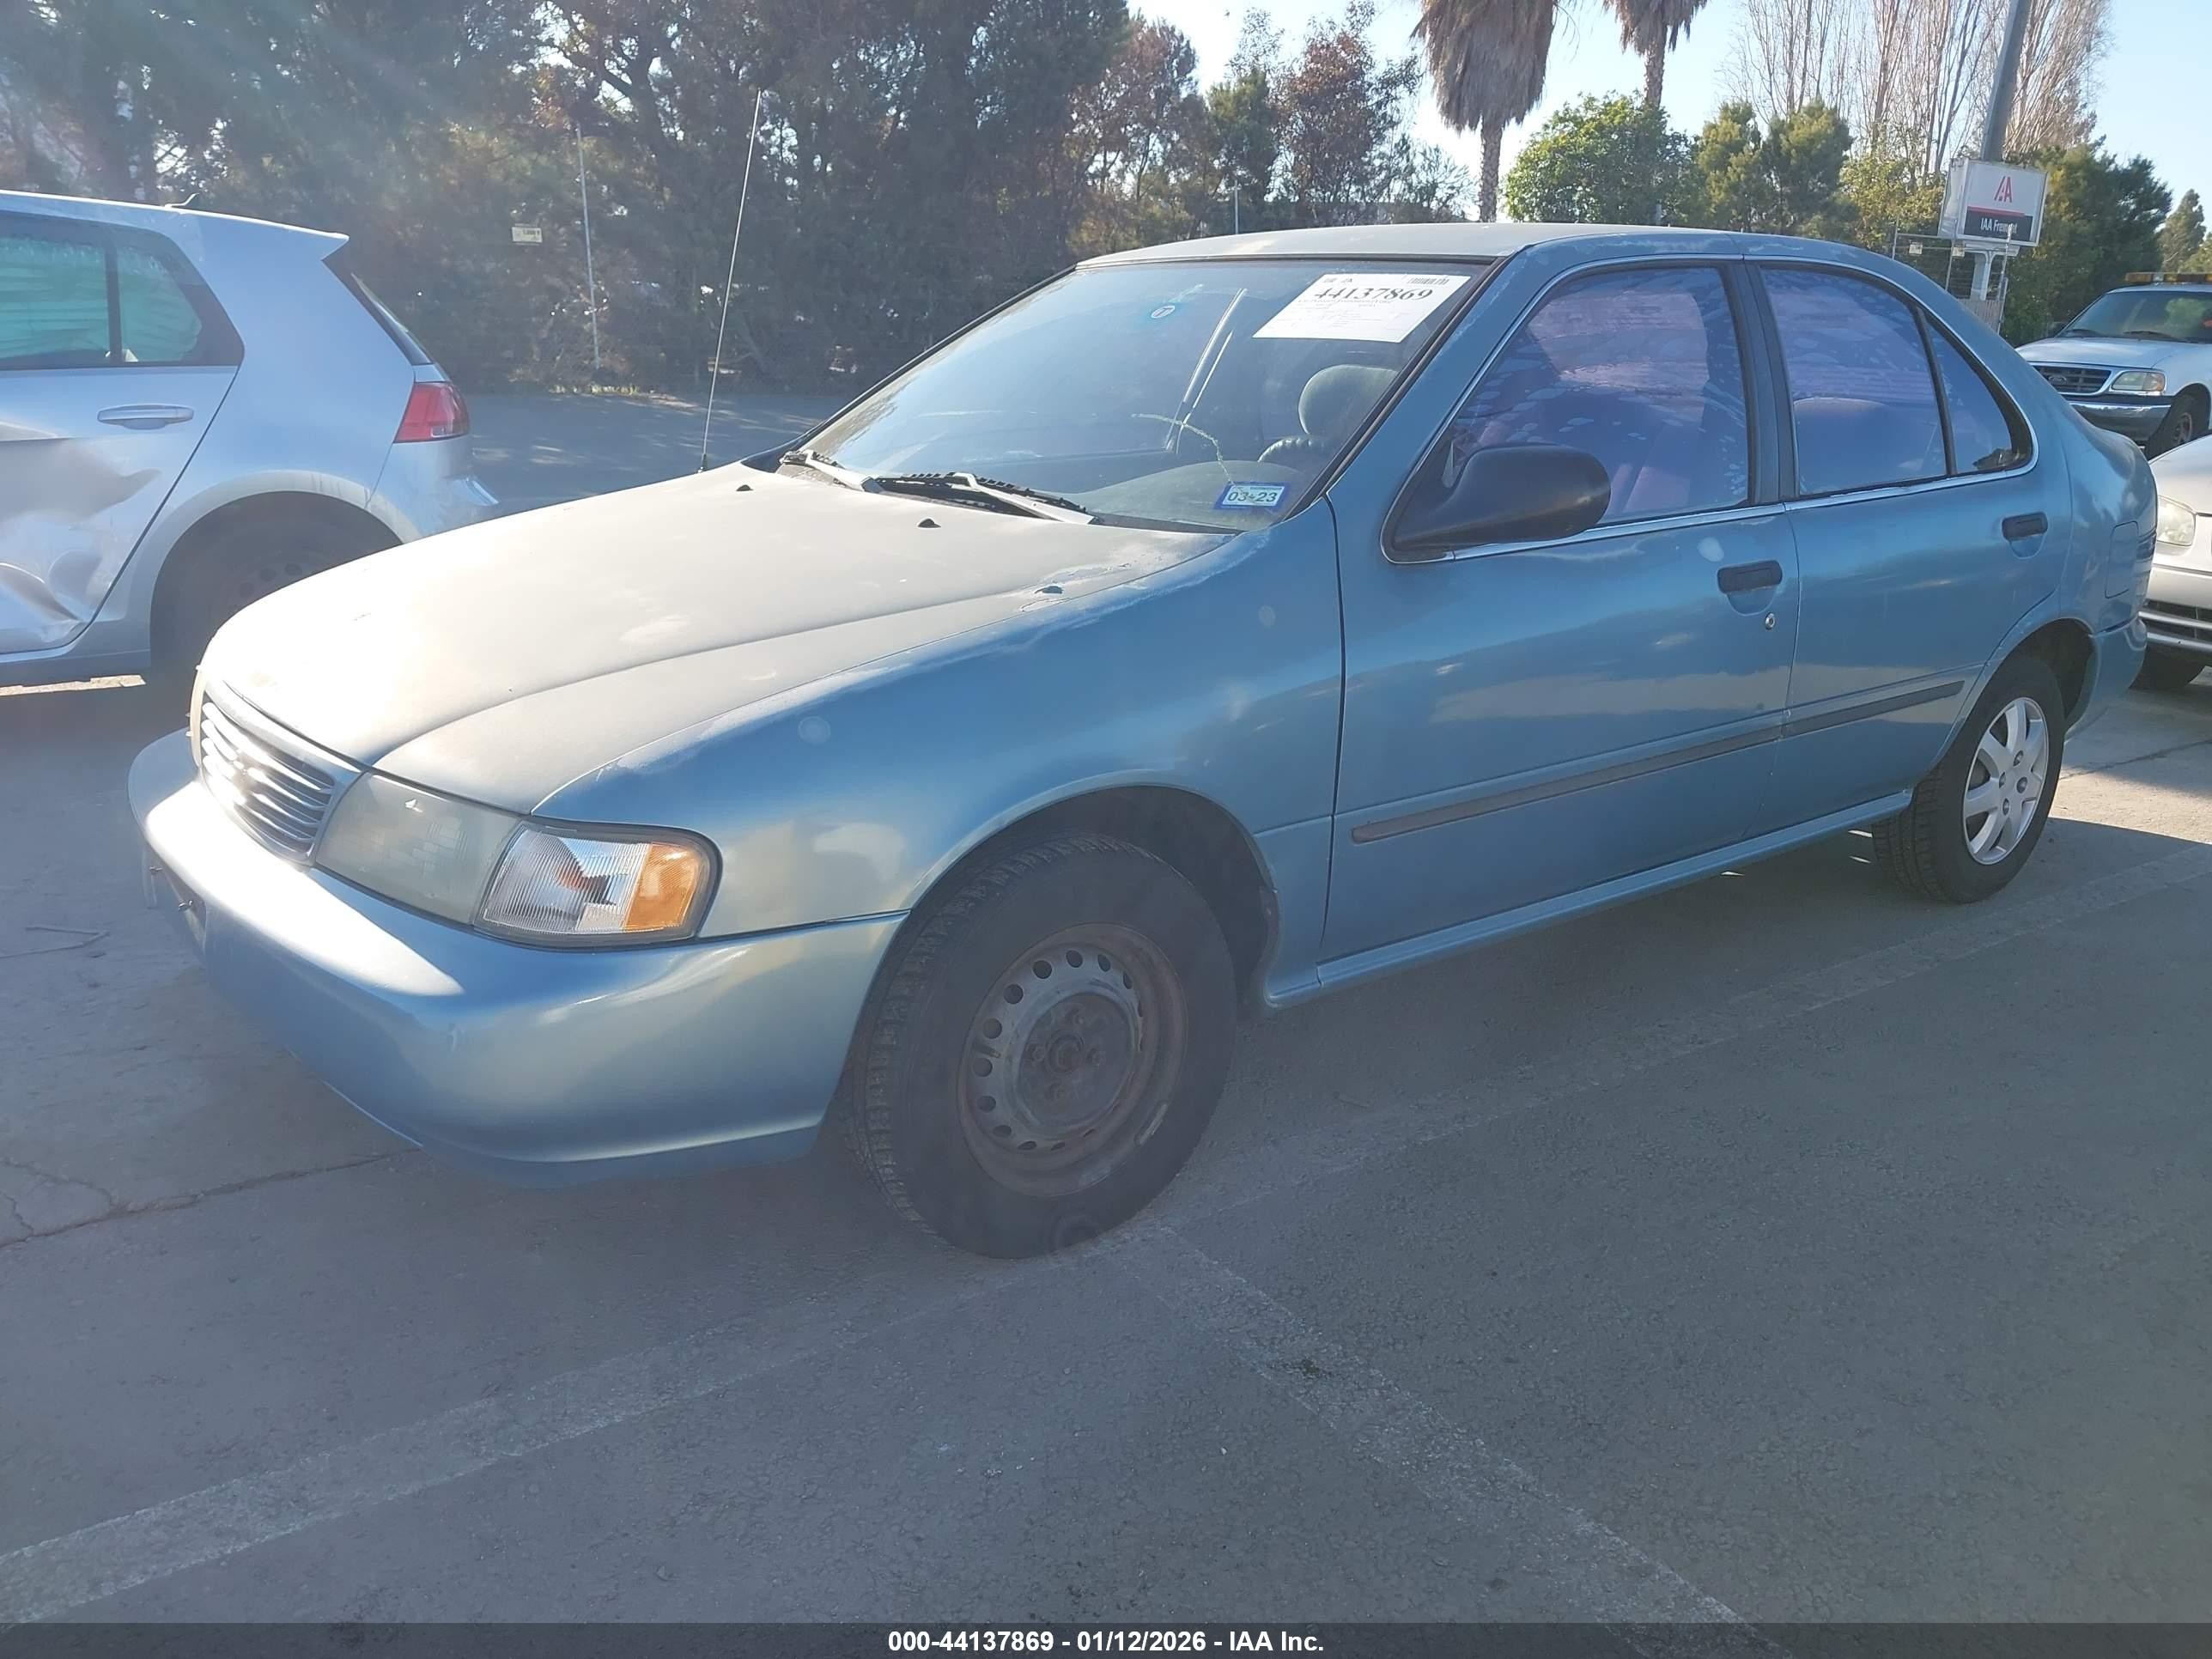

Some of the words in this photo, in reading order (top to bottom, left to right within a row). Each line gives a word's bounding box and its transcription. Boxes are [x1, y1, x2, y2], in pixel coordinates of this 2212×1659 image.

[1981, 217, 1992, 231] IAA
[1993, 219, 2017, 234] Fremnt
[1314, 288, 1433, 301] 44137869
